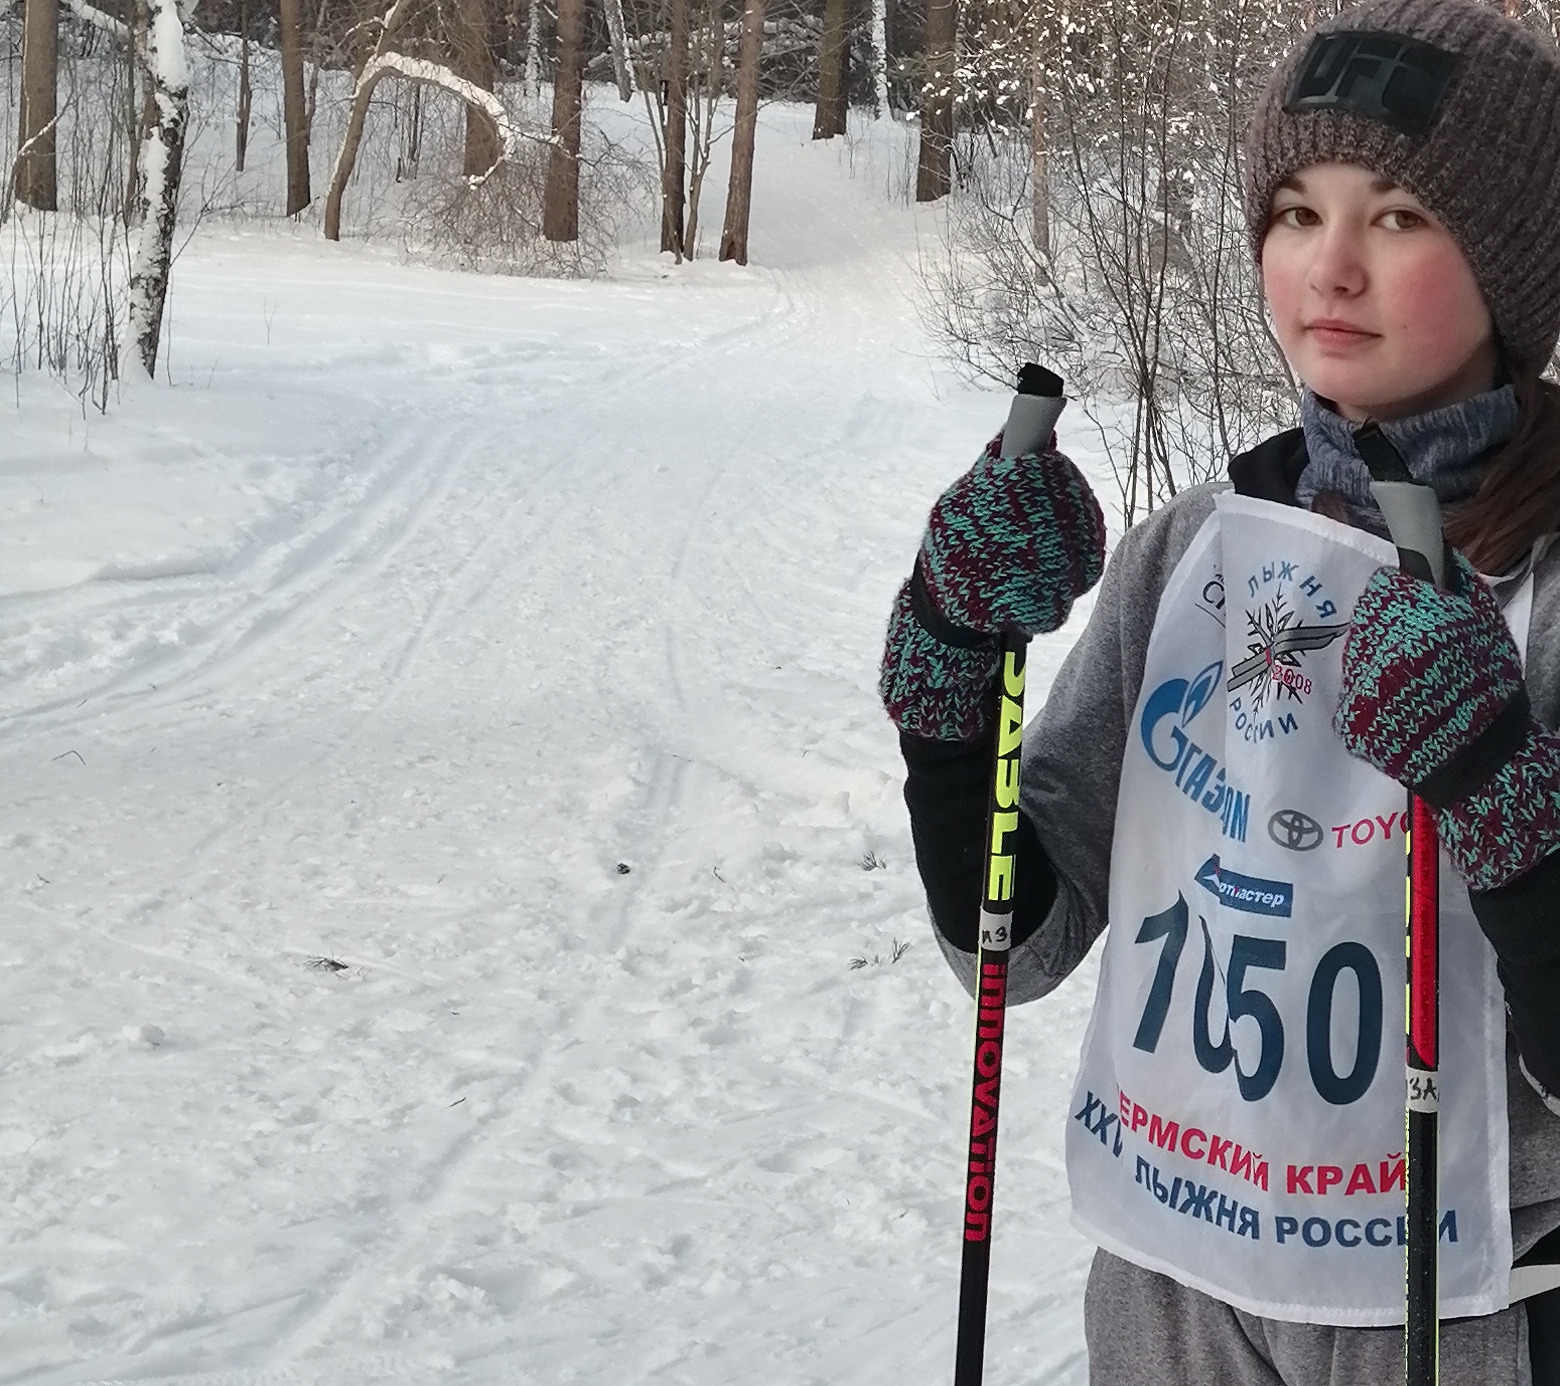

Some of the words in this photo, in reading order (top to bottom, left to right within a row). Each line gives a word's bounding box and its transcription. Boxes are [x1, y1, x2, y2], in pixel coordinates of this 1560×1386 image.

[1248, 561, 1337, 619] ЛЫЖНЯ
[1272, 665, 1312, 694] 2008
[1133, 890, 1383, 1104] 1050
[1119, 1090, 1269, 1194] ЕРМСКИЙ
[1286, 1152, 1407, 1195] КРАЙ
[1135, 1155, 1261, 1240] ЛЫЖНЯ
